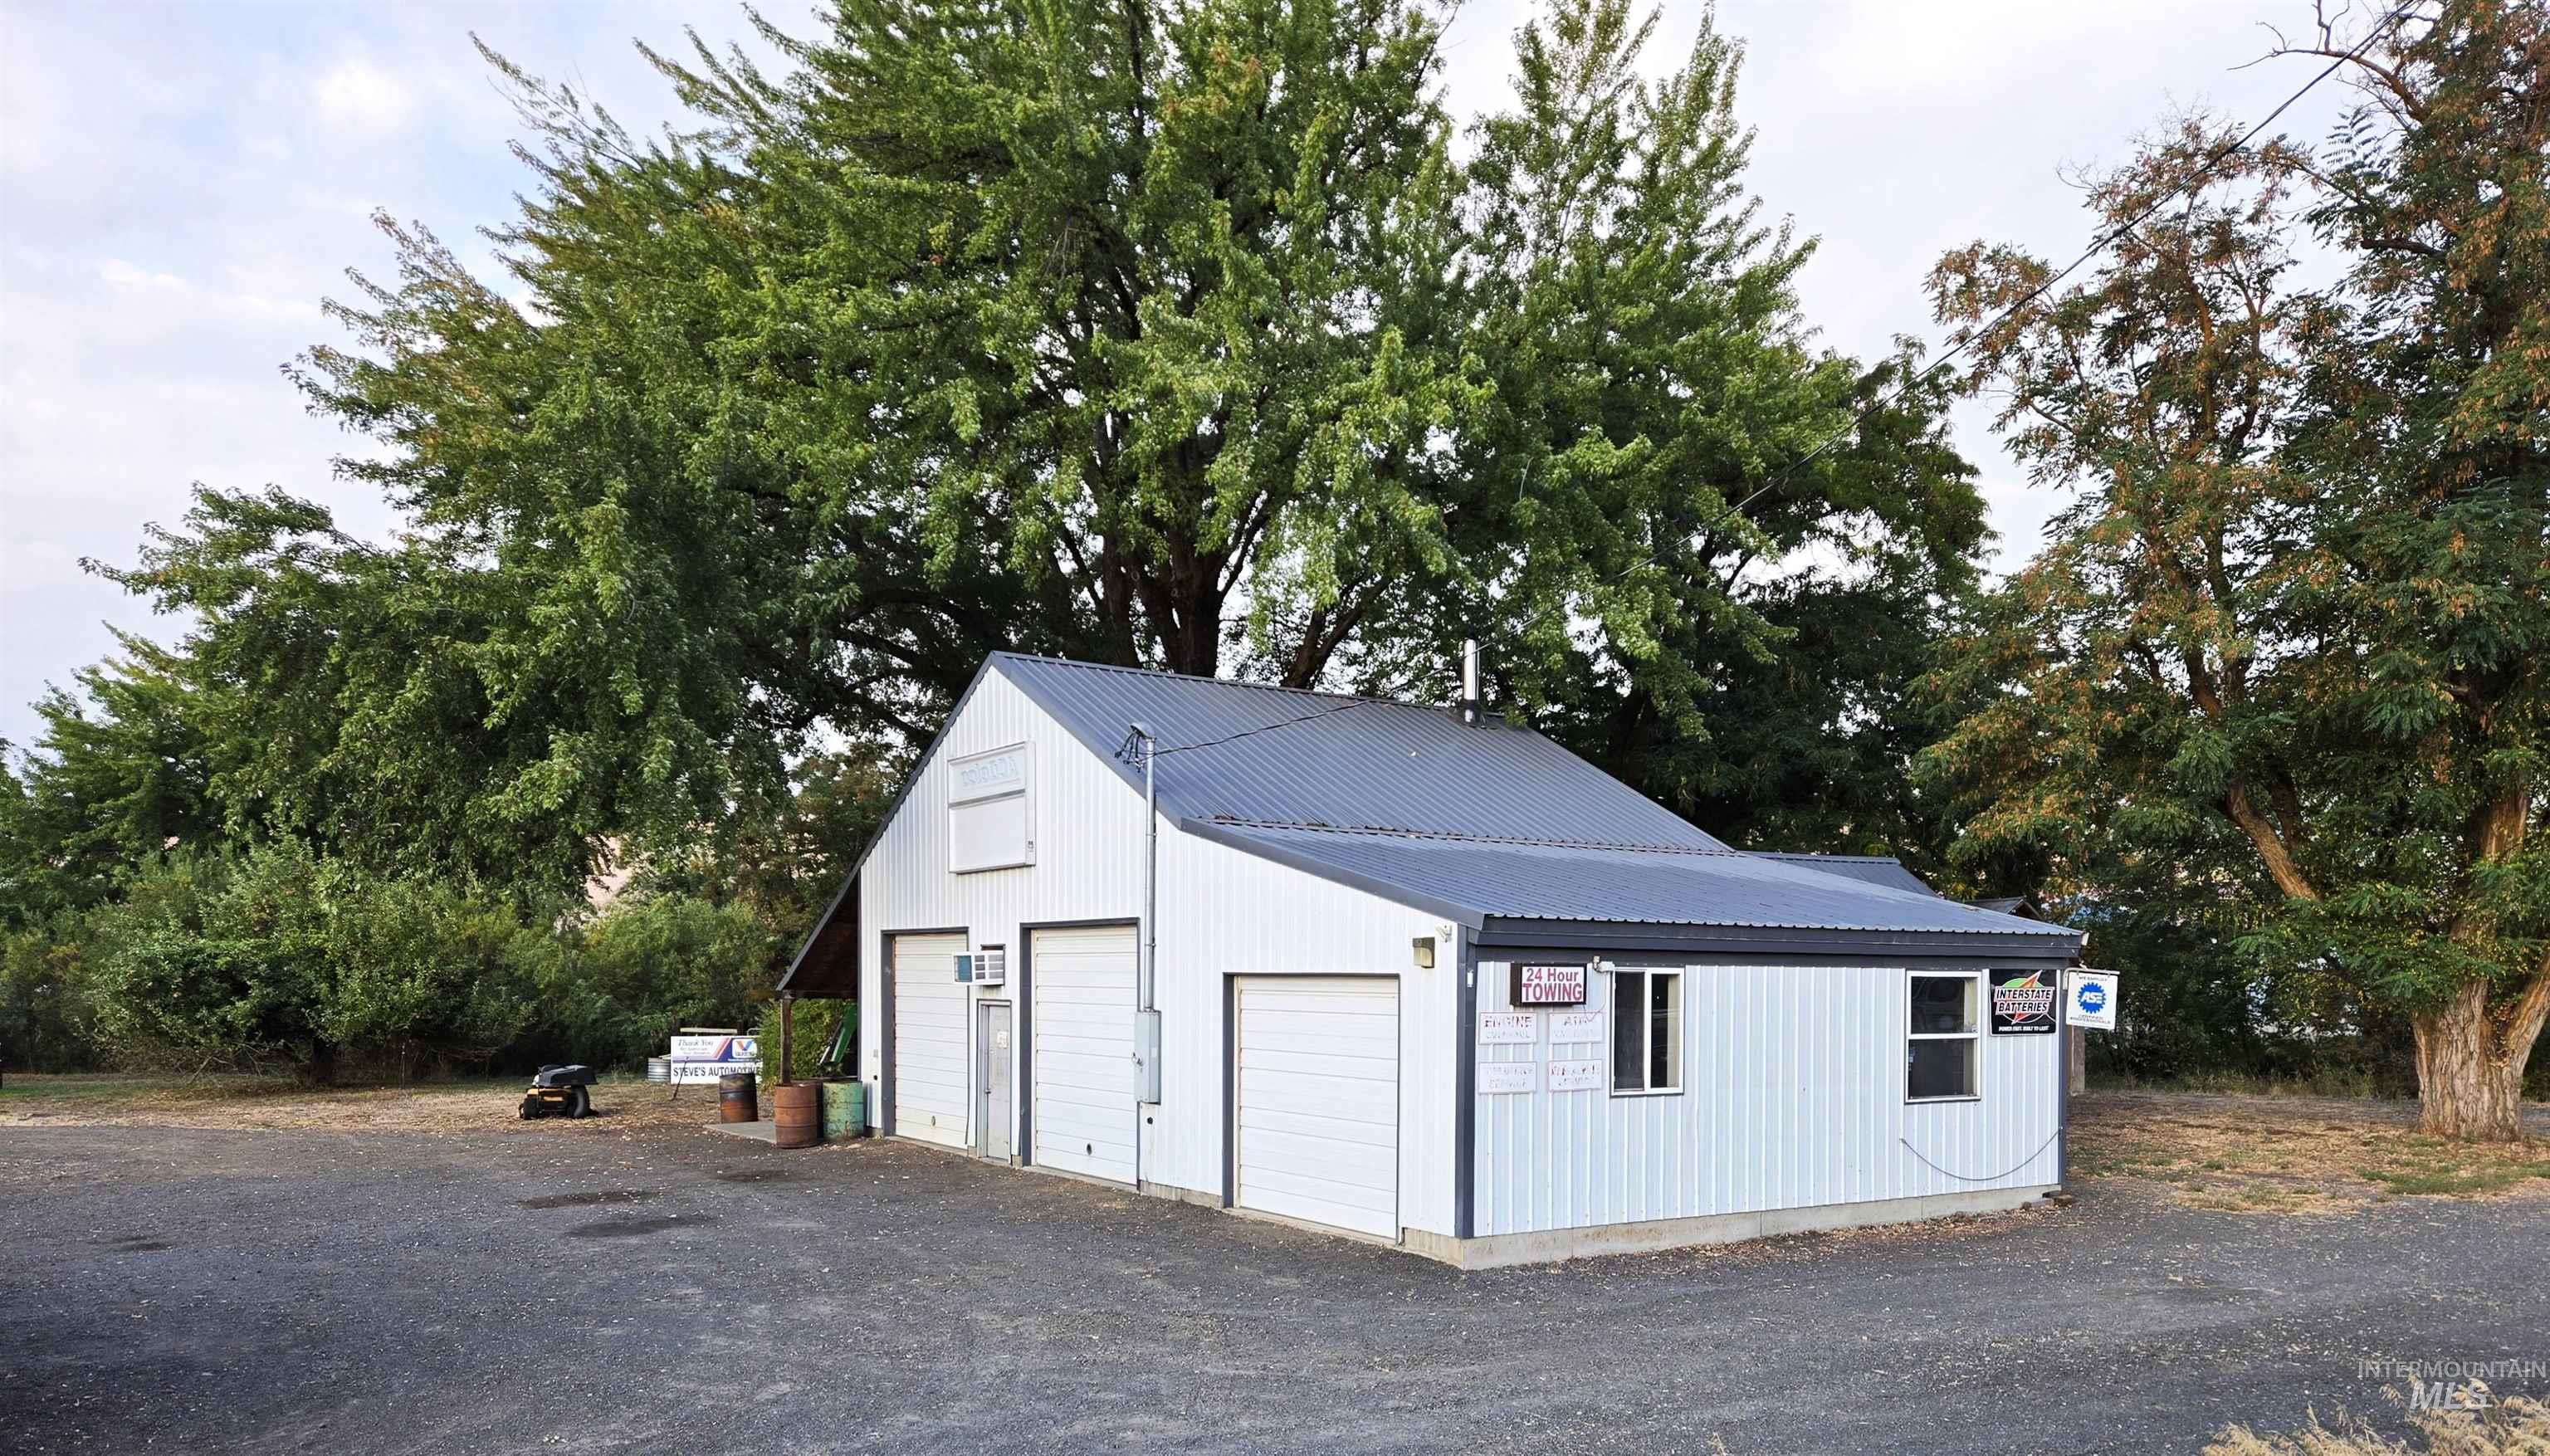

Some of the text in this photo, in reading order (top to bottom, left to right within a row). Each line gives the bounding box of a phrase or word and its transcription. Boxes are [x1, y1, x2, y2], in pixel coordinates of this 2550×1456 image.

[1526, 968, 1579, 982] 24 Hour
[1522, 983, 1583, 1001] TOWING
[1996, 989, 2051, 1000] INTERSTATE
[2080, 991, 2103, 1004] ASE
[1999, 1002, 2048, 1013] BATTERIES
[673, 1067, 706, 1077] STEVE'S
